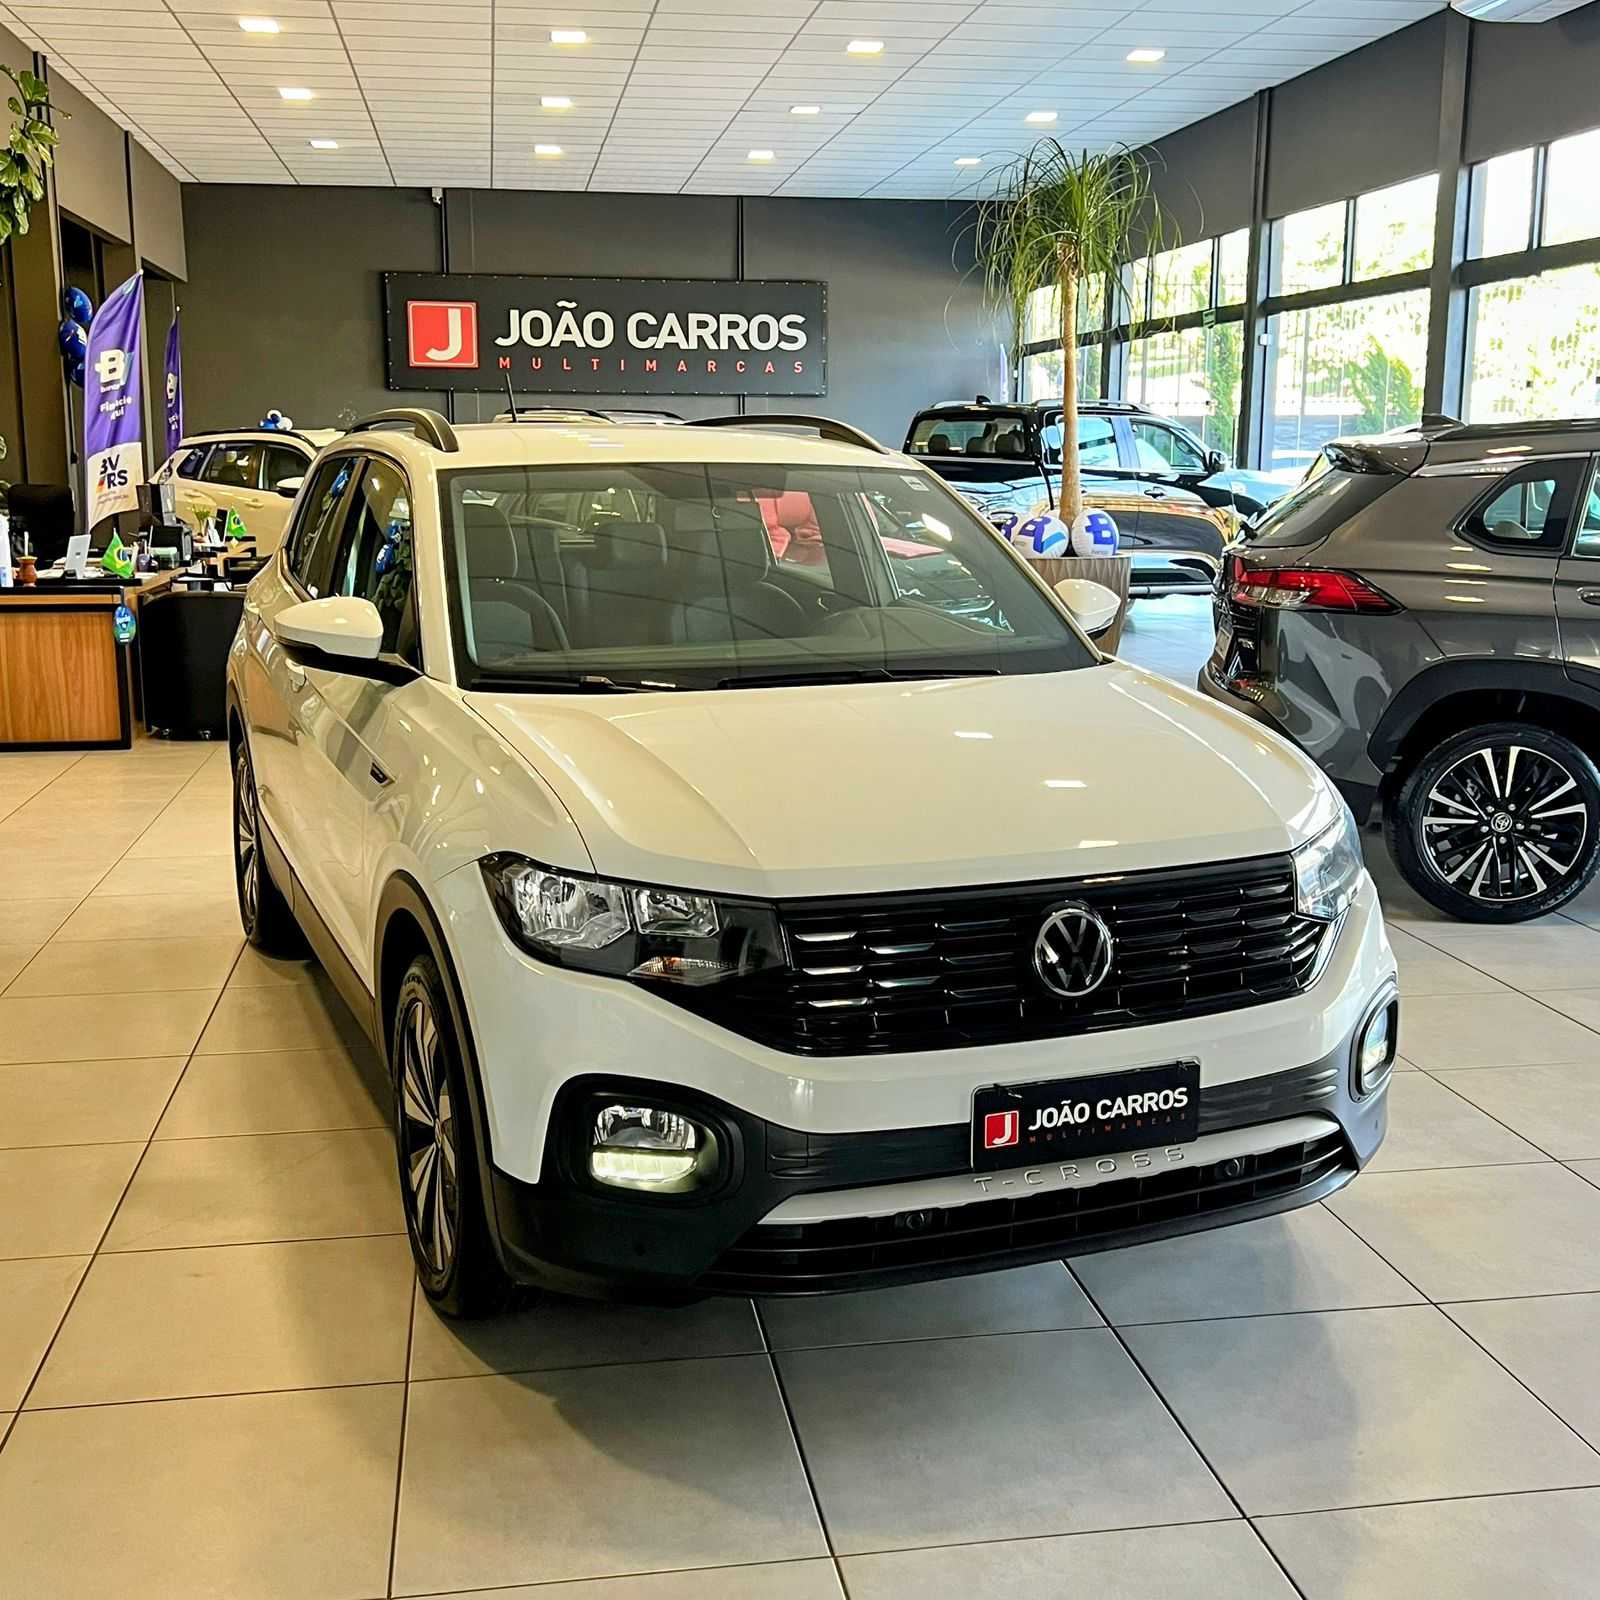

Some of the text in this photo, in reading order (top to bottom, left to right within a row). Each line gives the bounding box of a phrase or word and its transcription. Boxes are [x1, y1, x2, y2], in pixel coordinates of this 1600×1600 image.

[424, 307, 463, 362] J
[493, 300, 808, 352] JOÃO CARROS
[498, 356, 804, 374] MULTIMARCAS
[992, 1112, 1013, 1145] J
[1027, 1086, 1189, 1131] JOÃO CARROS
[973, 1146, 1185, 1193] T-CROSS
